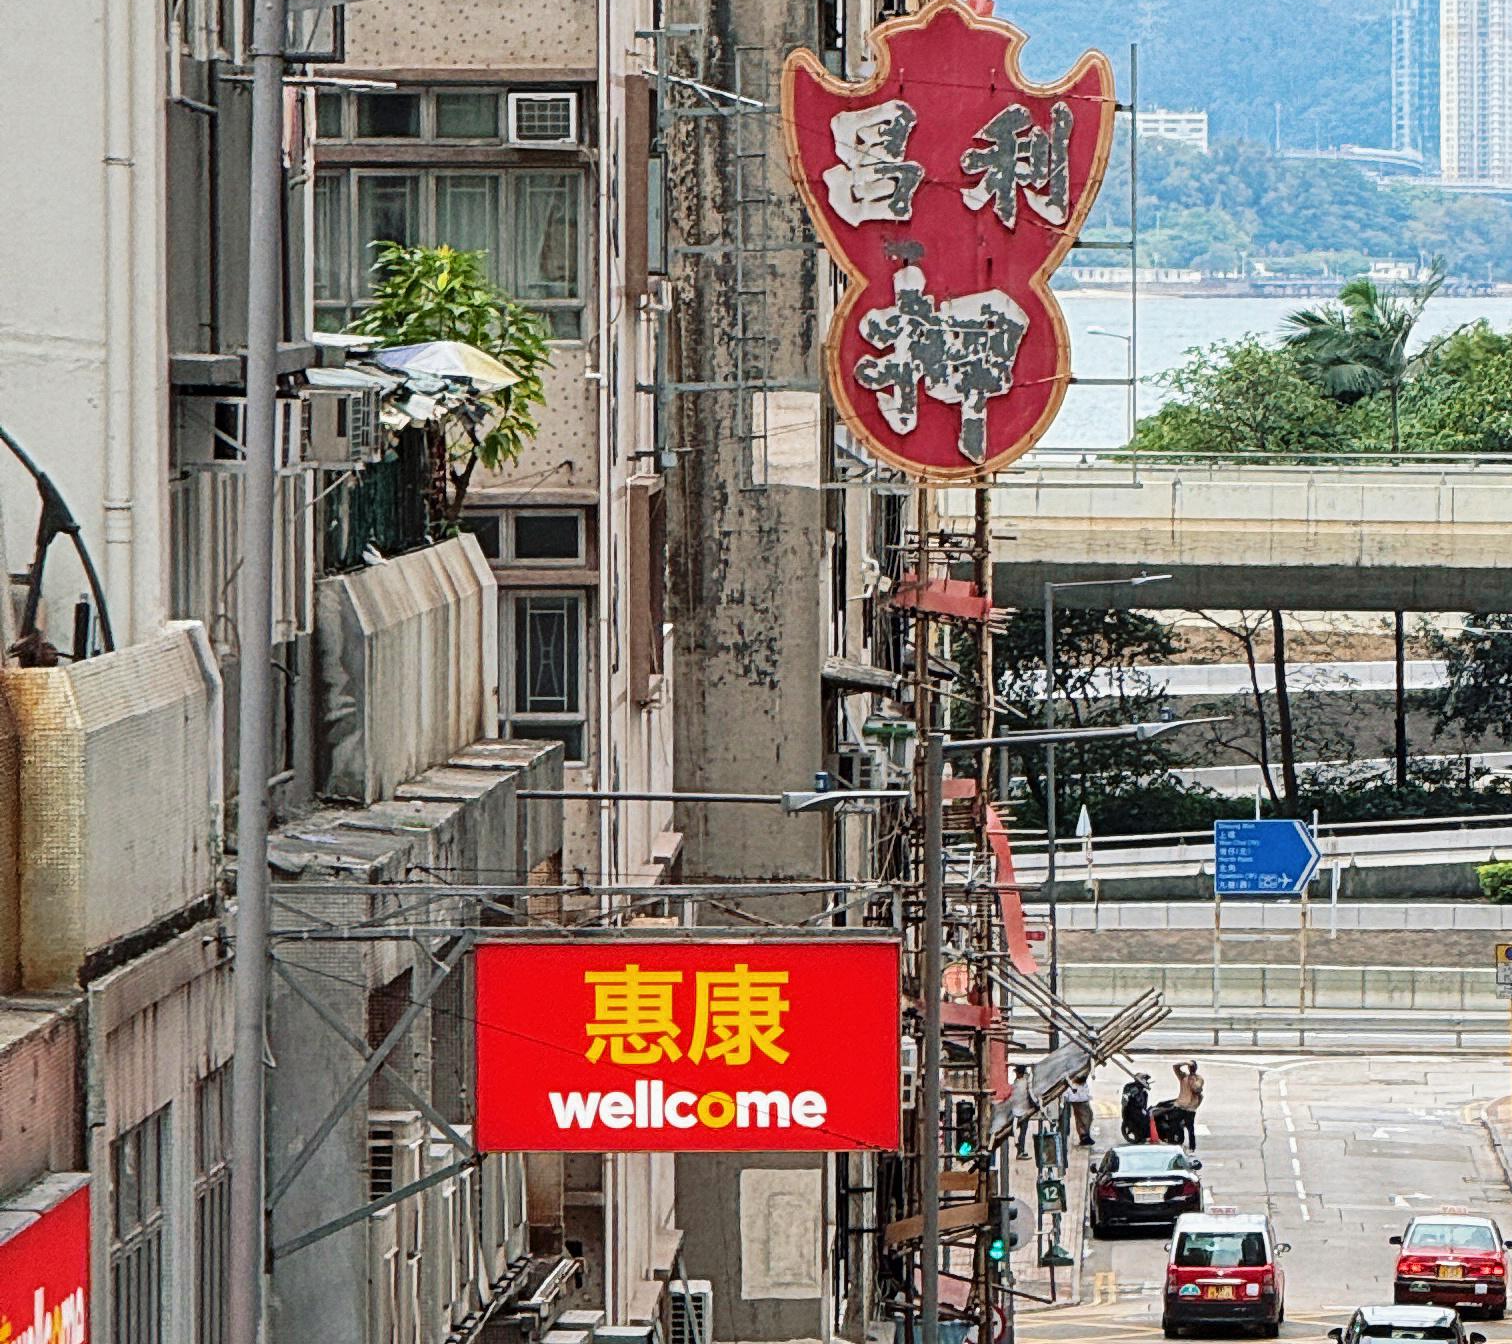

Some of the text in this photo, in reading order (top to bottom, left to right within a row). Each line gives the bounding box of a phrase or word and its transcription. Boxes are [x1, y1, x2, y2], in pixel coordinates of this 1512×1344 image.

[854, 264, 1029, 465] 押
[585, 963, 791, 1066] 惠康
[549, 1079, 828, 1129] wellcome
